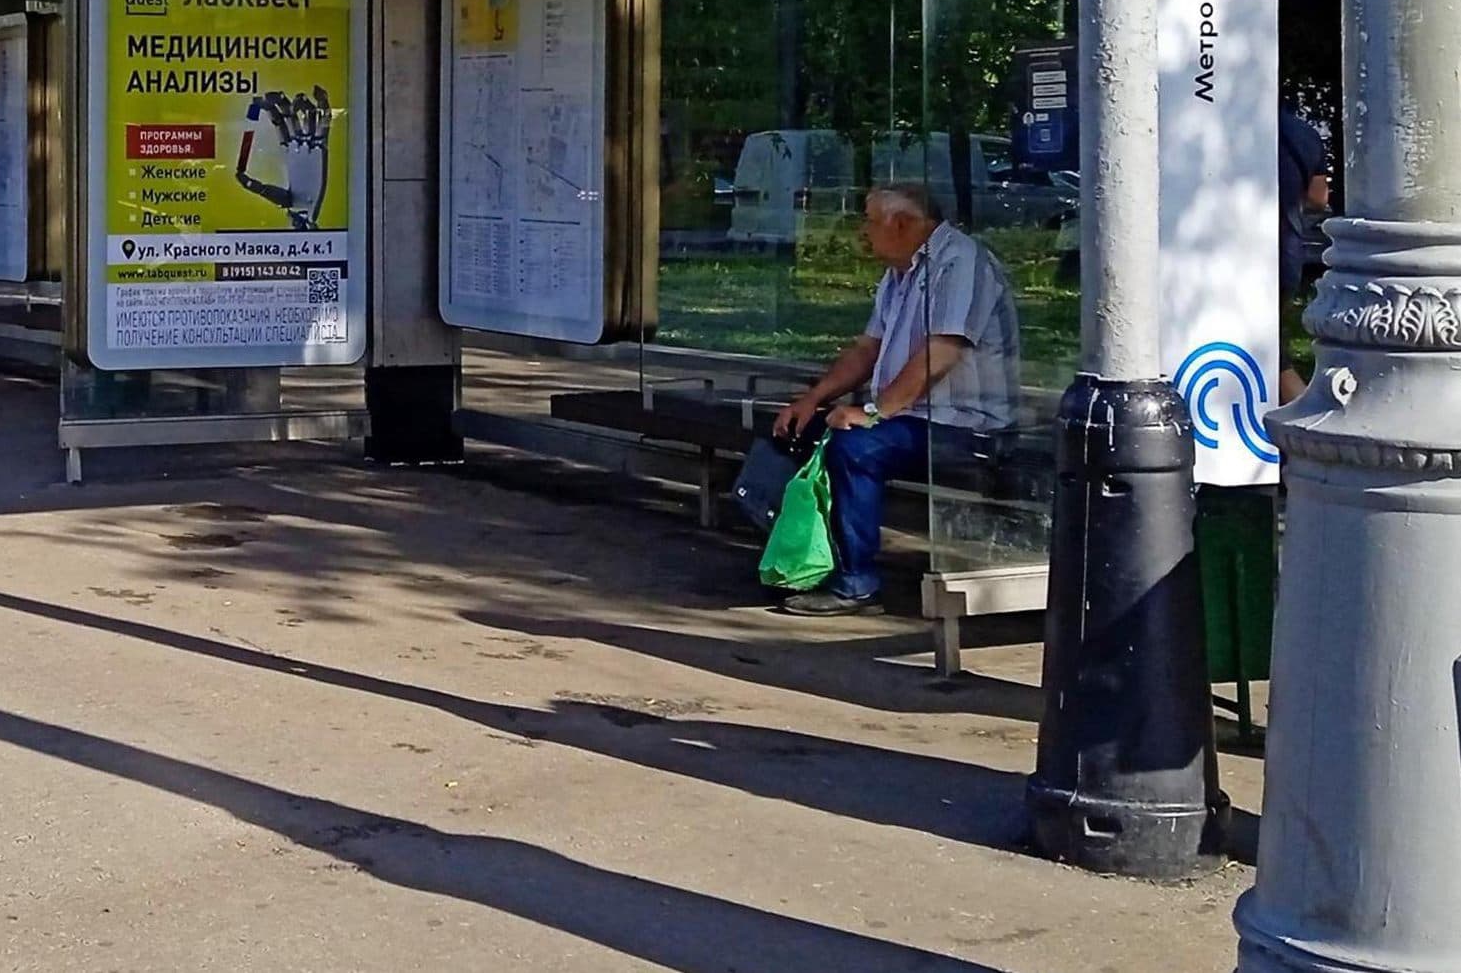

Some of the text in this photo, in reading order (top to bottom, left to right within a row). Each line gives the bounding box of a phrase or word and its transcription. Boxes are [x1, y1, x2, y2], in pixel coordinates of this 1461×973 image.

[127, 34, 329, 62] МЕДИЦИНСКИЕ
[1194, 2, 1218, 103] Метро
[126, 70, 259, 94] АНАЛИЗЫ
[140, 130, 203, 141] ПРОГРАММЫ
[141, 165, 206, 179] Женские
[141, 189, 207, 205] Мужские
[141, 212, 201, 228] Детские
[137, 240, 333, 260] ул. Красного Маяка, д.4 к.1
[117, 268, 207, 283] www.labquest.ru
[258, 266, 274, 277] 143
[276, 266, 288, 277] 40
[289, 266, 301, 276] 42
[116, 311, 167, 328] ИМЕЮТСЯ
[275, 307, 339, 325] НЕОБХОДИМО
[116, 325, 339, 347] ПОЛУЧЕНИЕ КОНСУЛЬТАЦИИ СПЕЦИАЛИСТА
